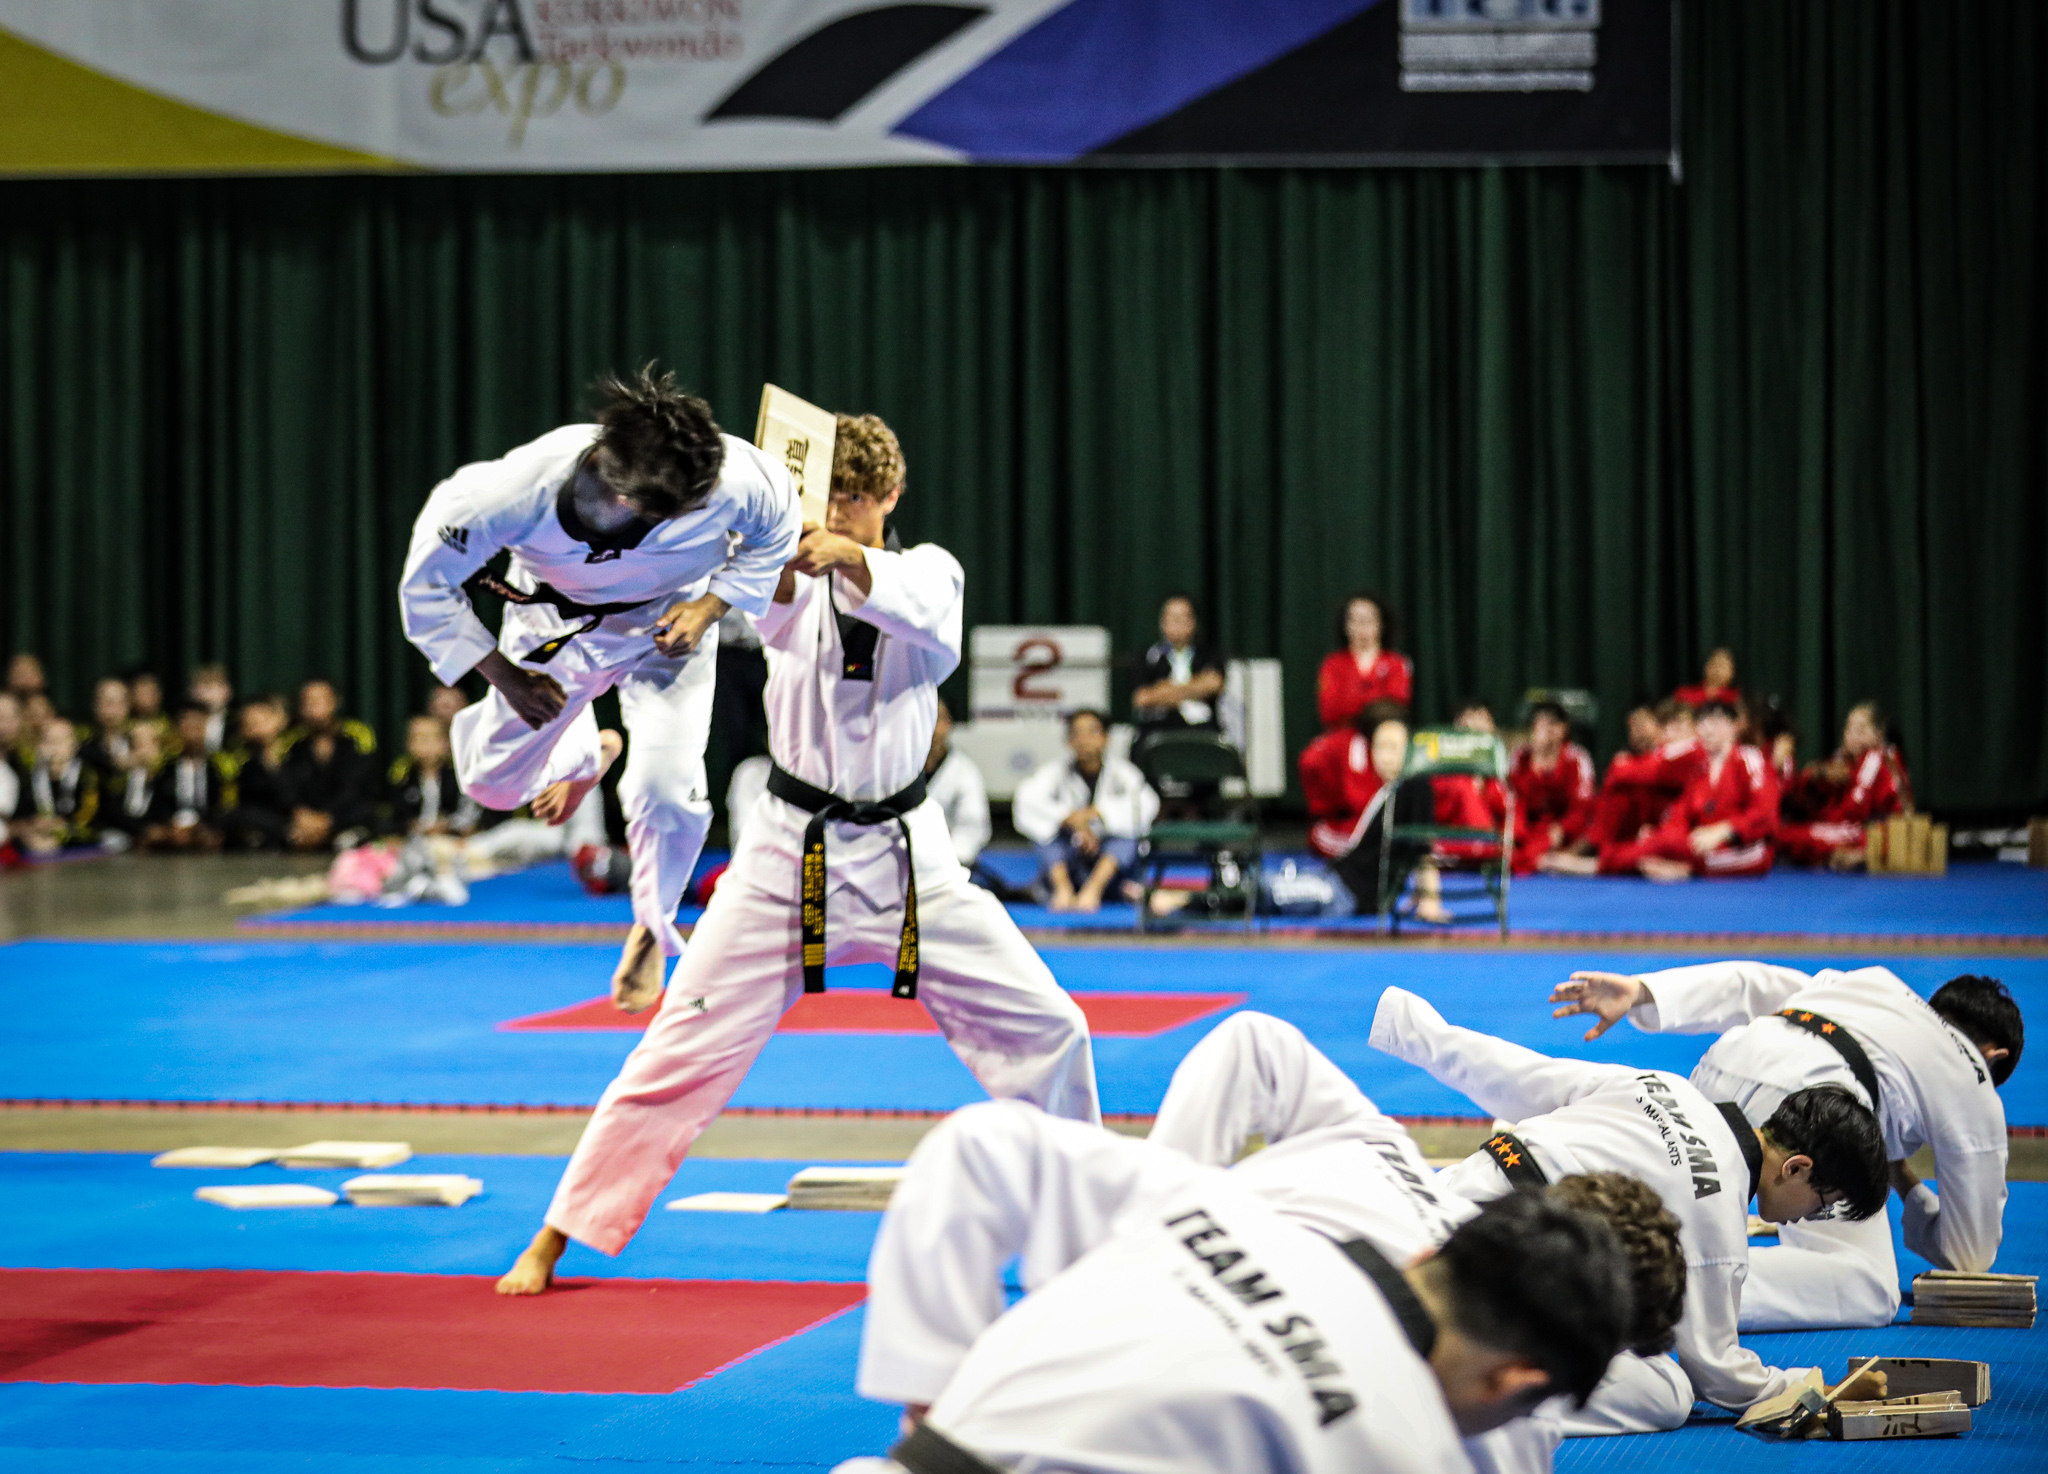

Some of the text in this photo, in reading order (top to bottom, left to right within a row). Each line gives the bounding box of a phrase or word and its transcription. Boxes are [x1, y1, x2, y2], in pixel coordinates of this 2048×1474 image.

[340, 0, 538, 65] USA
[428, 56, 627, 149] expo
[1012, 638, 1062, 701] 2
[1667, 1141, 1682, 1166] ARTS
[1680, 1132, 1721, 1199] SMA
[1164, 1208, 1285, 1309] TEAM
[1262, 1313, 1361, 1428] SMA
